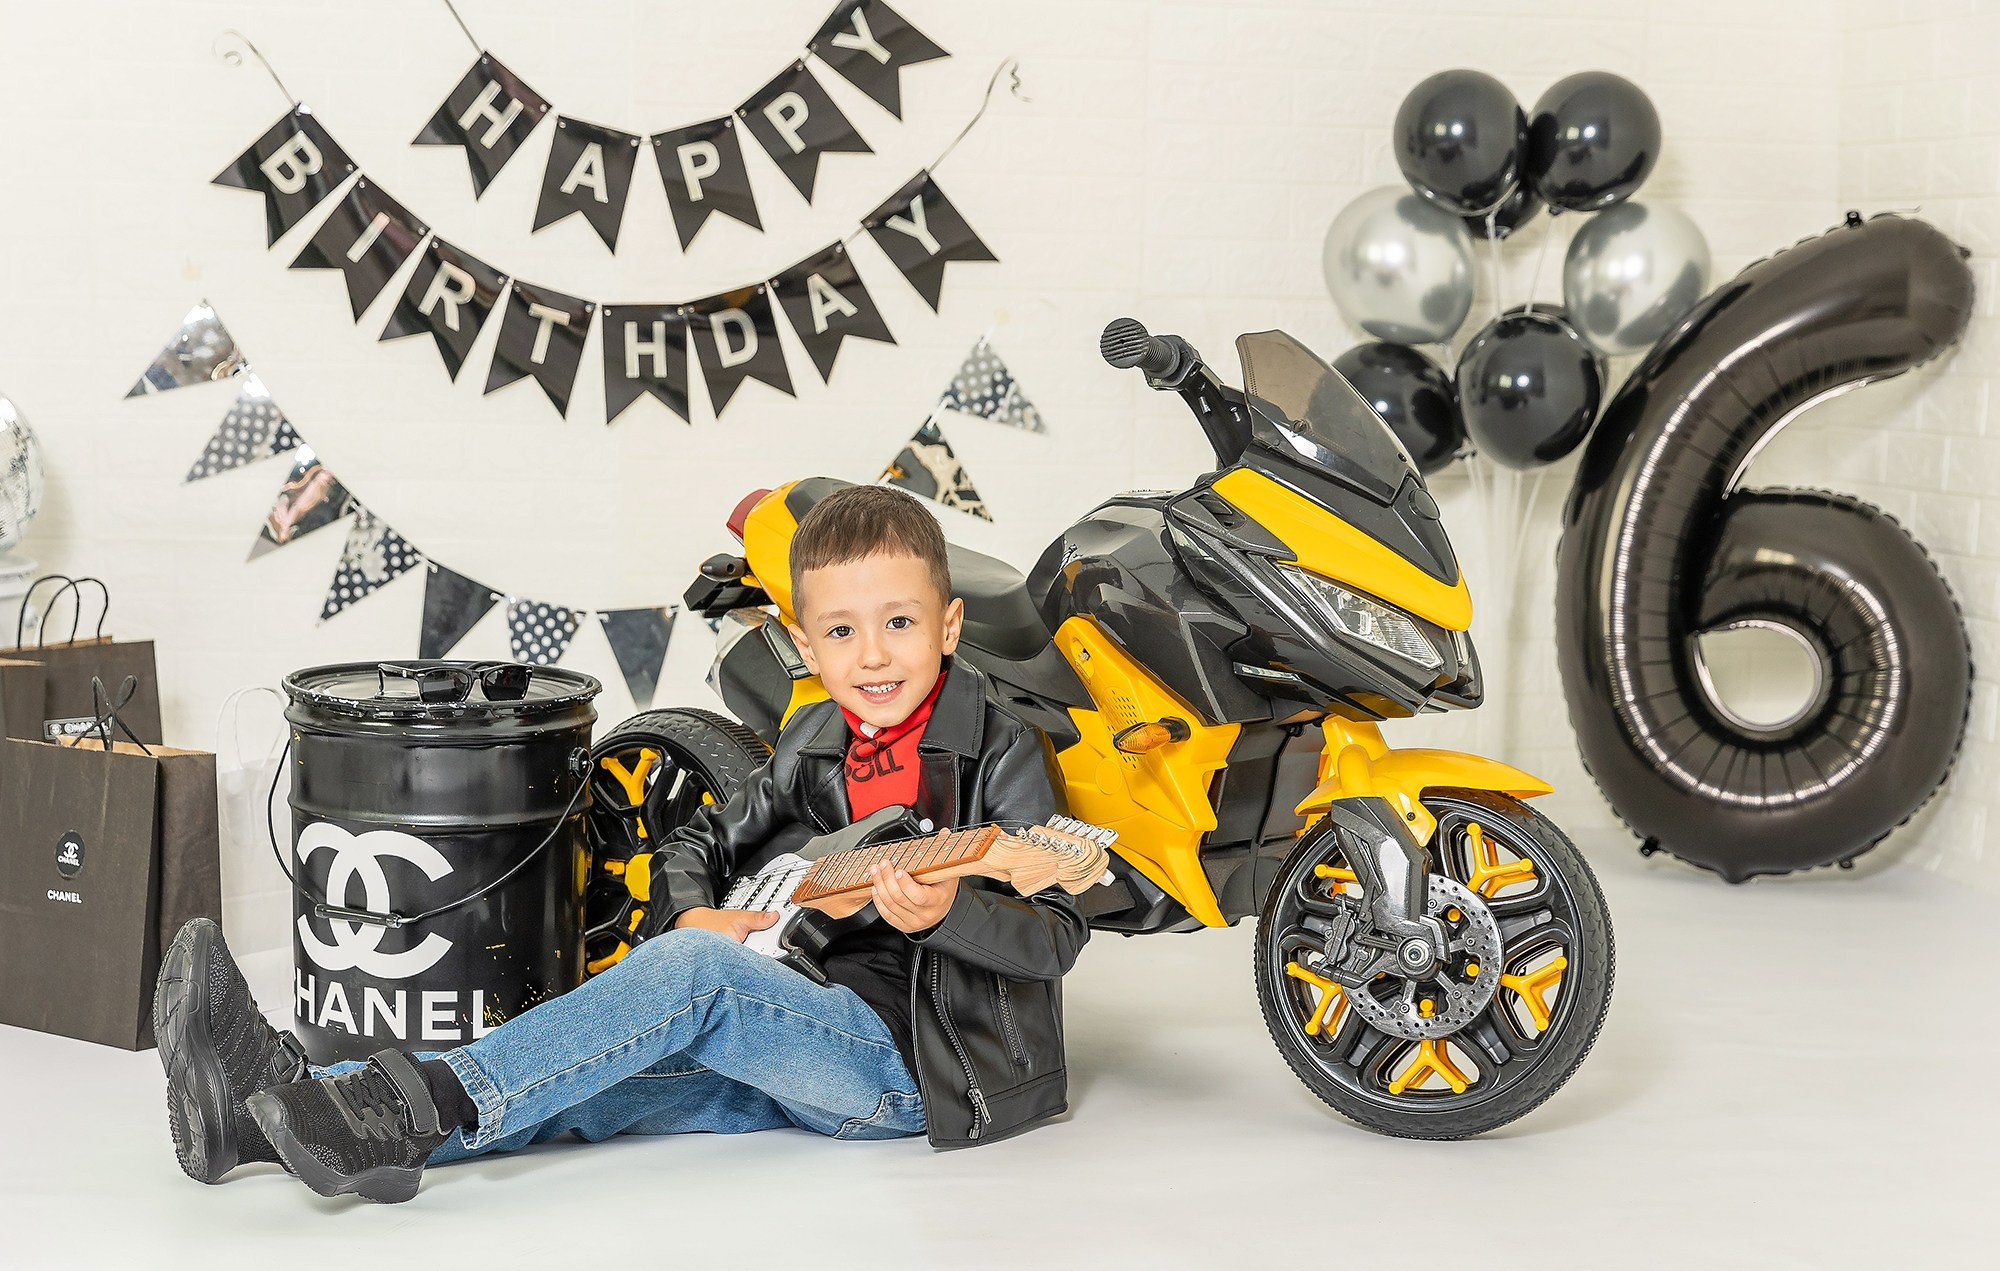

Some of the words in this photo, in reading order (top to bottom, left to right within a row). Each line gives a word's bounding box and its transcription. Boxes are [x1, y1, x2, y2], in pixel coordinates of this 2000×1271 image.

[458, 6, 892, 203] HAPPY
[260, 130, 941, 380] BIRTHDAY
[1556, 211, 1975, 882] 6
[47, 889, 82, 903] CHANEL
[296, 967, 501, 1041] HANEL
